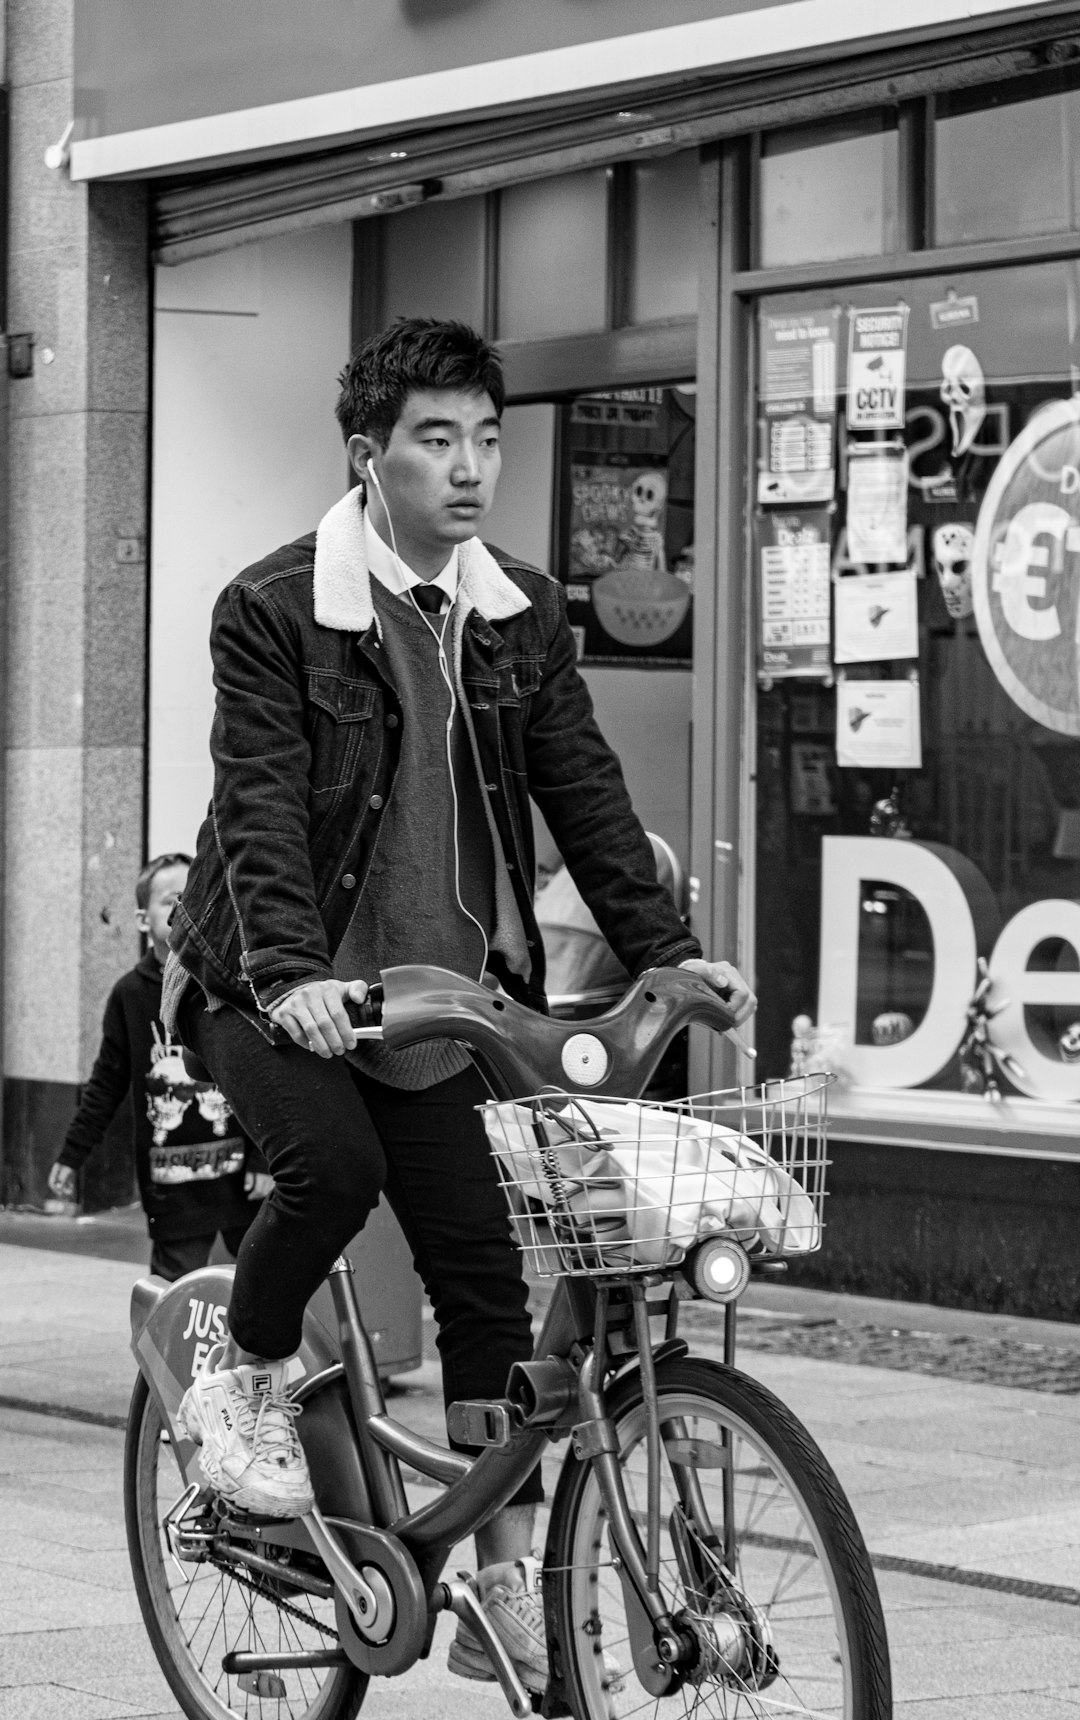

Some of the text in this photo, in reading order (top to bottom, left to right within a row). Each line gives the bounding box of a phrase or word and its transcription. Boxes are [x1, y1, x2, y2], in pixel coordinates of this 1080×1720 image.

[857, 388, 896, 409] CCTV
[817, 835, 1080, 1101] De
[221, 1408, 233, 1431] FILA
